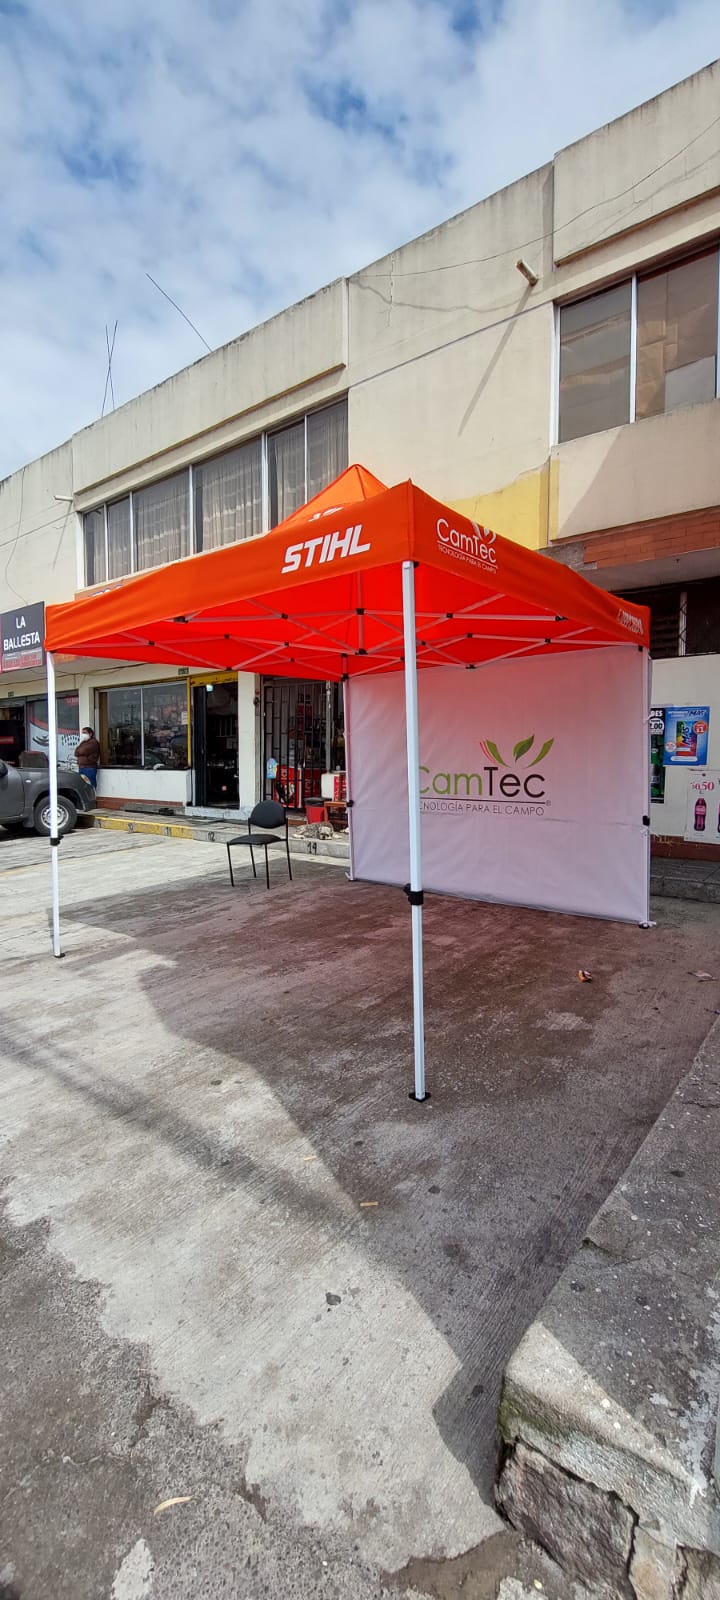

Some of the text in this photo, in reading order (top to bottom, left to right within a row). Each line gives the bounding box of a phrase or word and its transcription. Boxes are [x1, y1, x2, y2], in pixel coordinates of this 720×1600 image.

[281, 524, 371, 574] STIHL
[436, 518, 497, 563] CamTec
[15, 615, 26, 629] LA
[3, 631, 41, 651] BALLESTA
[419, 801, 545, 816] NOLOGÍA PARA EL CAMPO
[207, 831, 215, 842] 12
